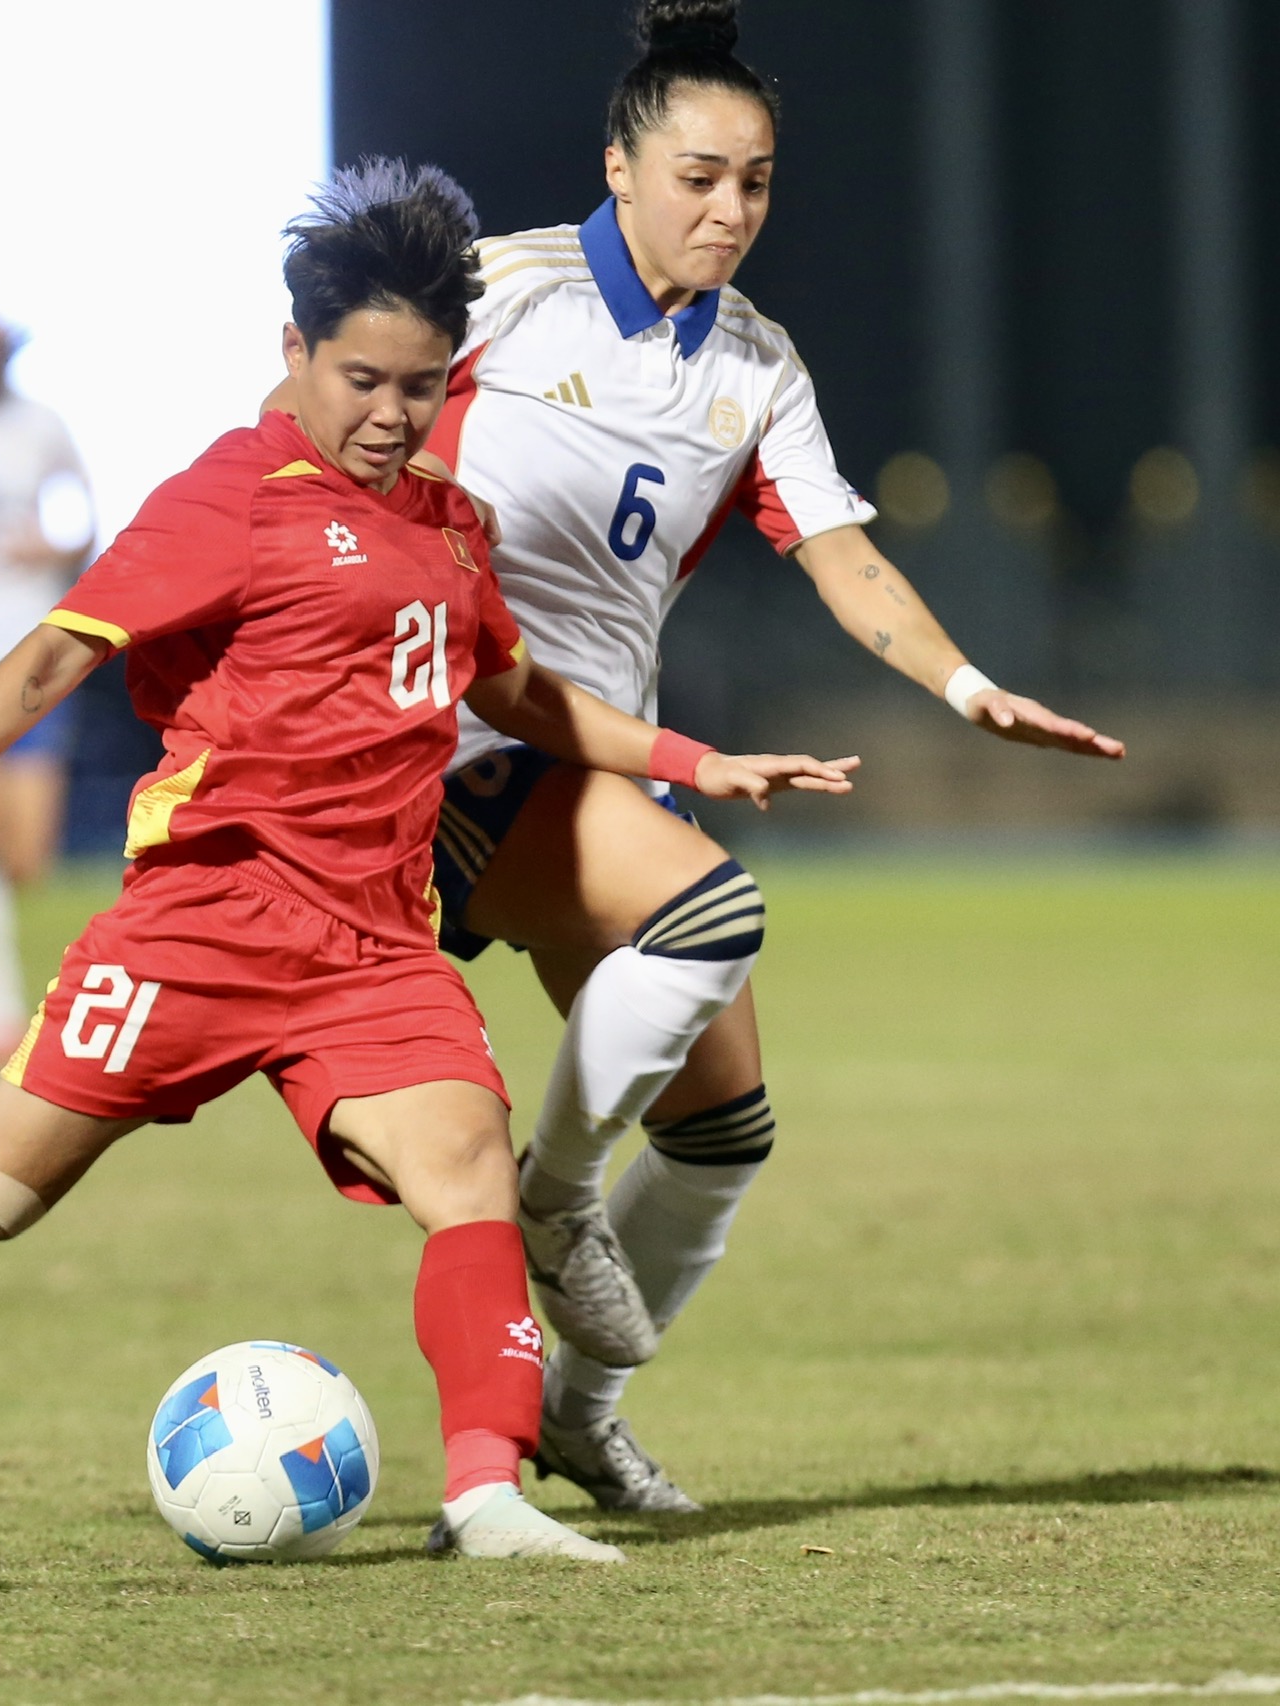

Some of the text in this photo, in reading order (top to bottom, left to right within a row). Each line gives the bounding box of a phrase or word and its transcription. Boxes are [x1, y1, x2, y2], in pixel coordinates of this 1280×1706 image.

[608, 462, 665, 561] 6
[388, 599, 452, 710] 21
[60, 964, 163, 1073] 21
[248, 1364, 272, 1419] molten
